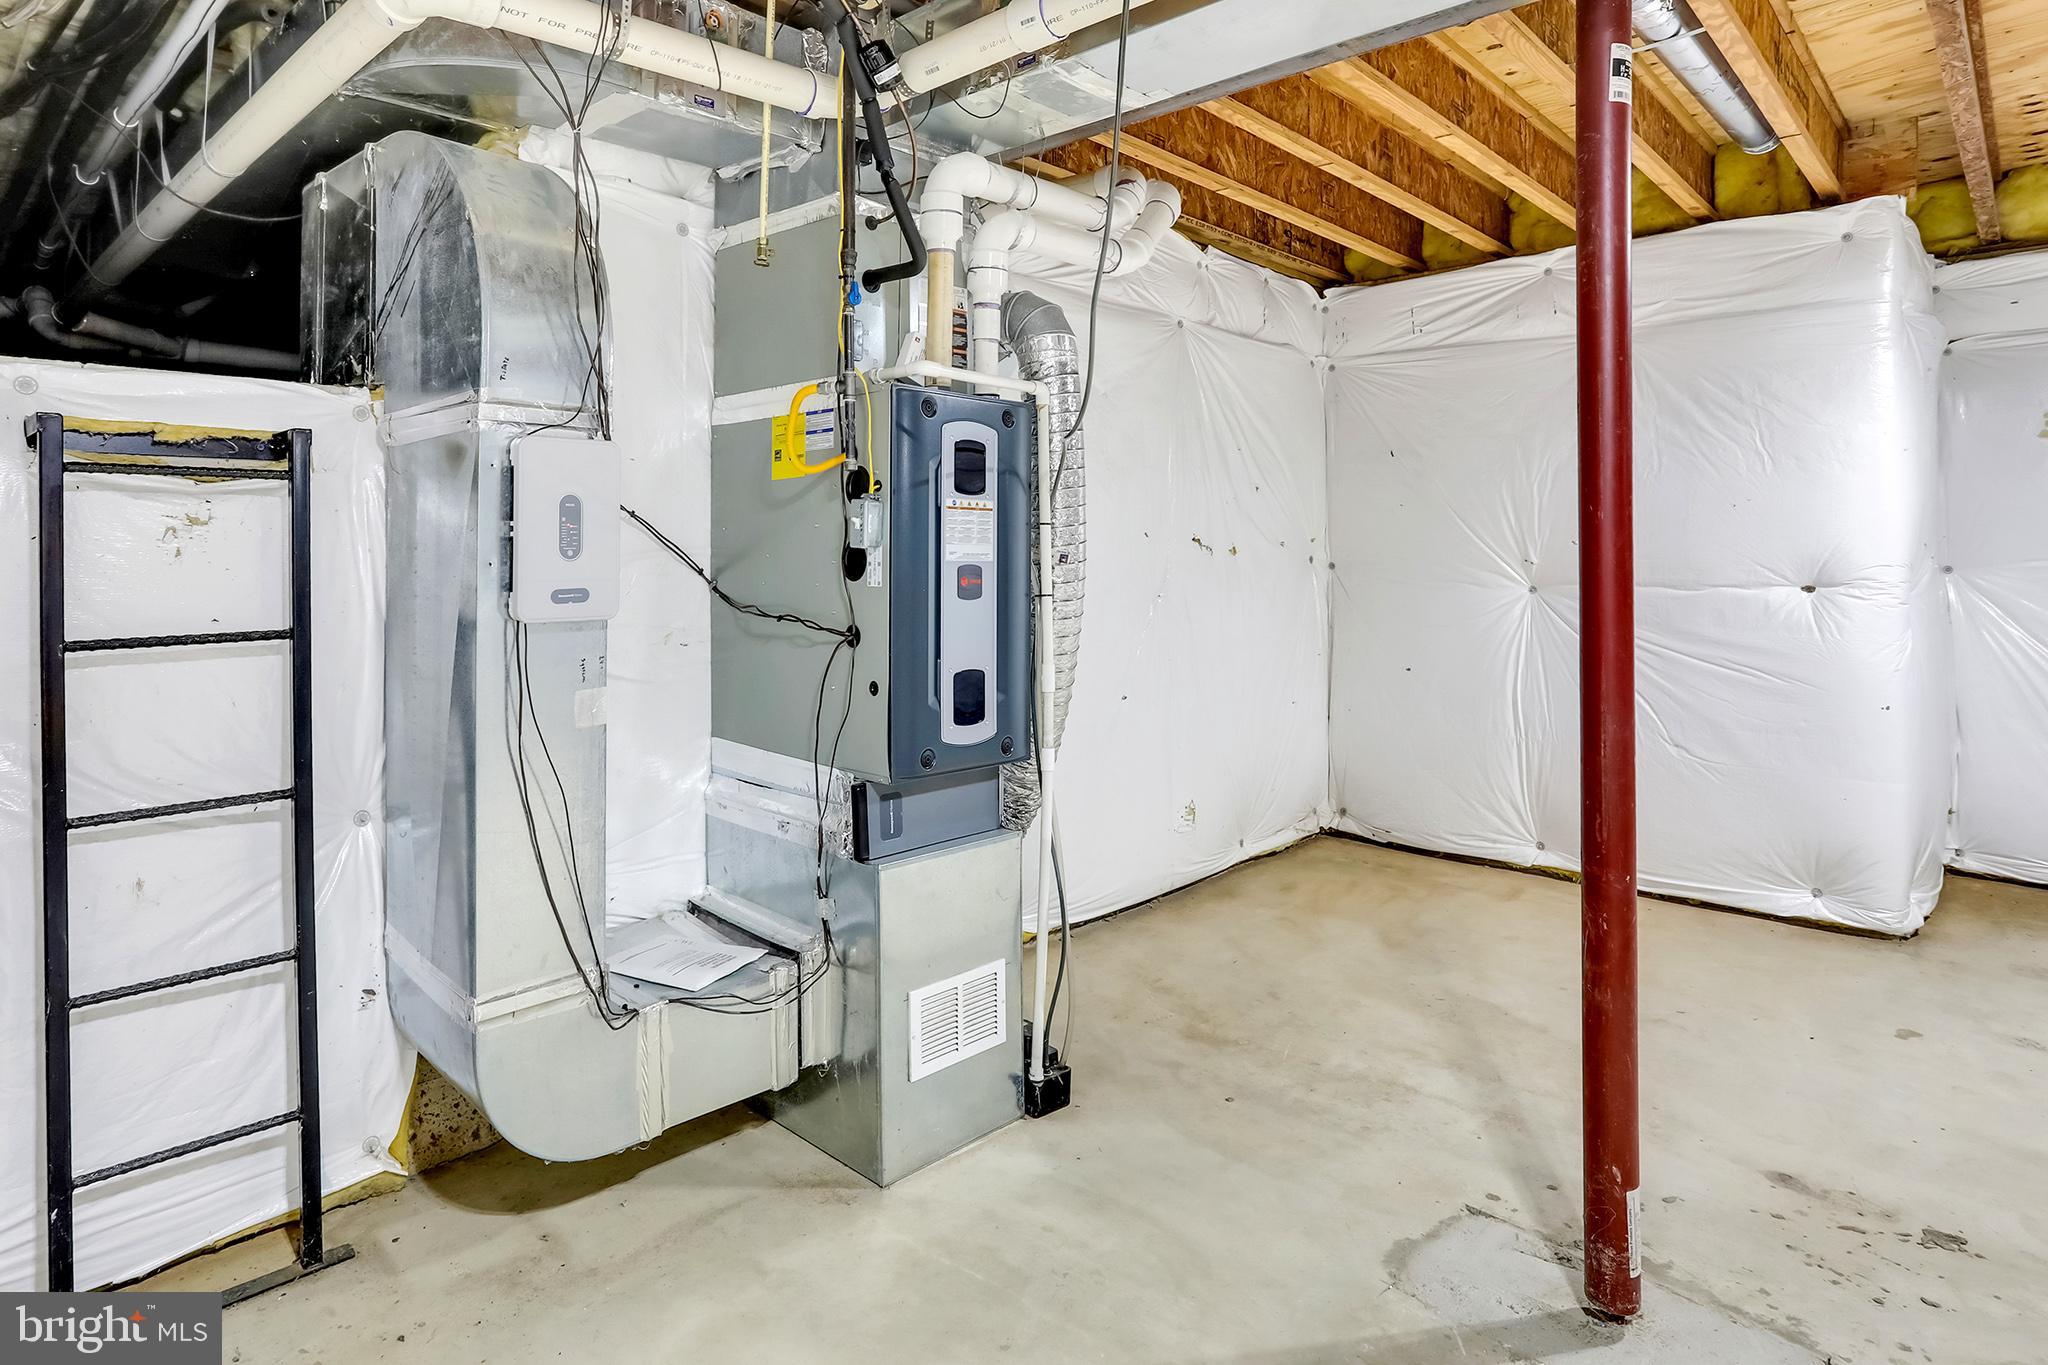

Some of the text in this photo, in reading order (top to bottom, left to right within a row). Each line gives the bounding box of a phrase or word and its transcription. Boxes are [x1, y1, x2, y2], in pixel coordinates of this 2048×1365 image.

[500, 6, 528, 18] NOT
[538, 17, 567, 30] FOR
[575, 27, 642, 52] PRERE
